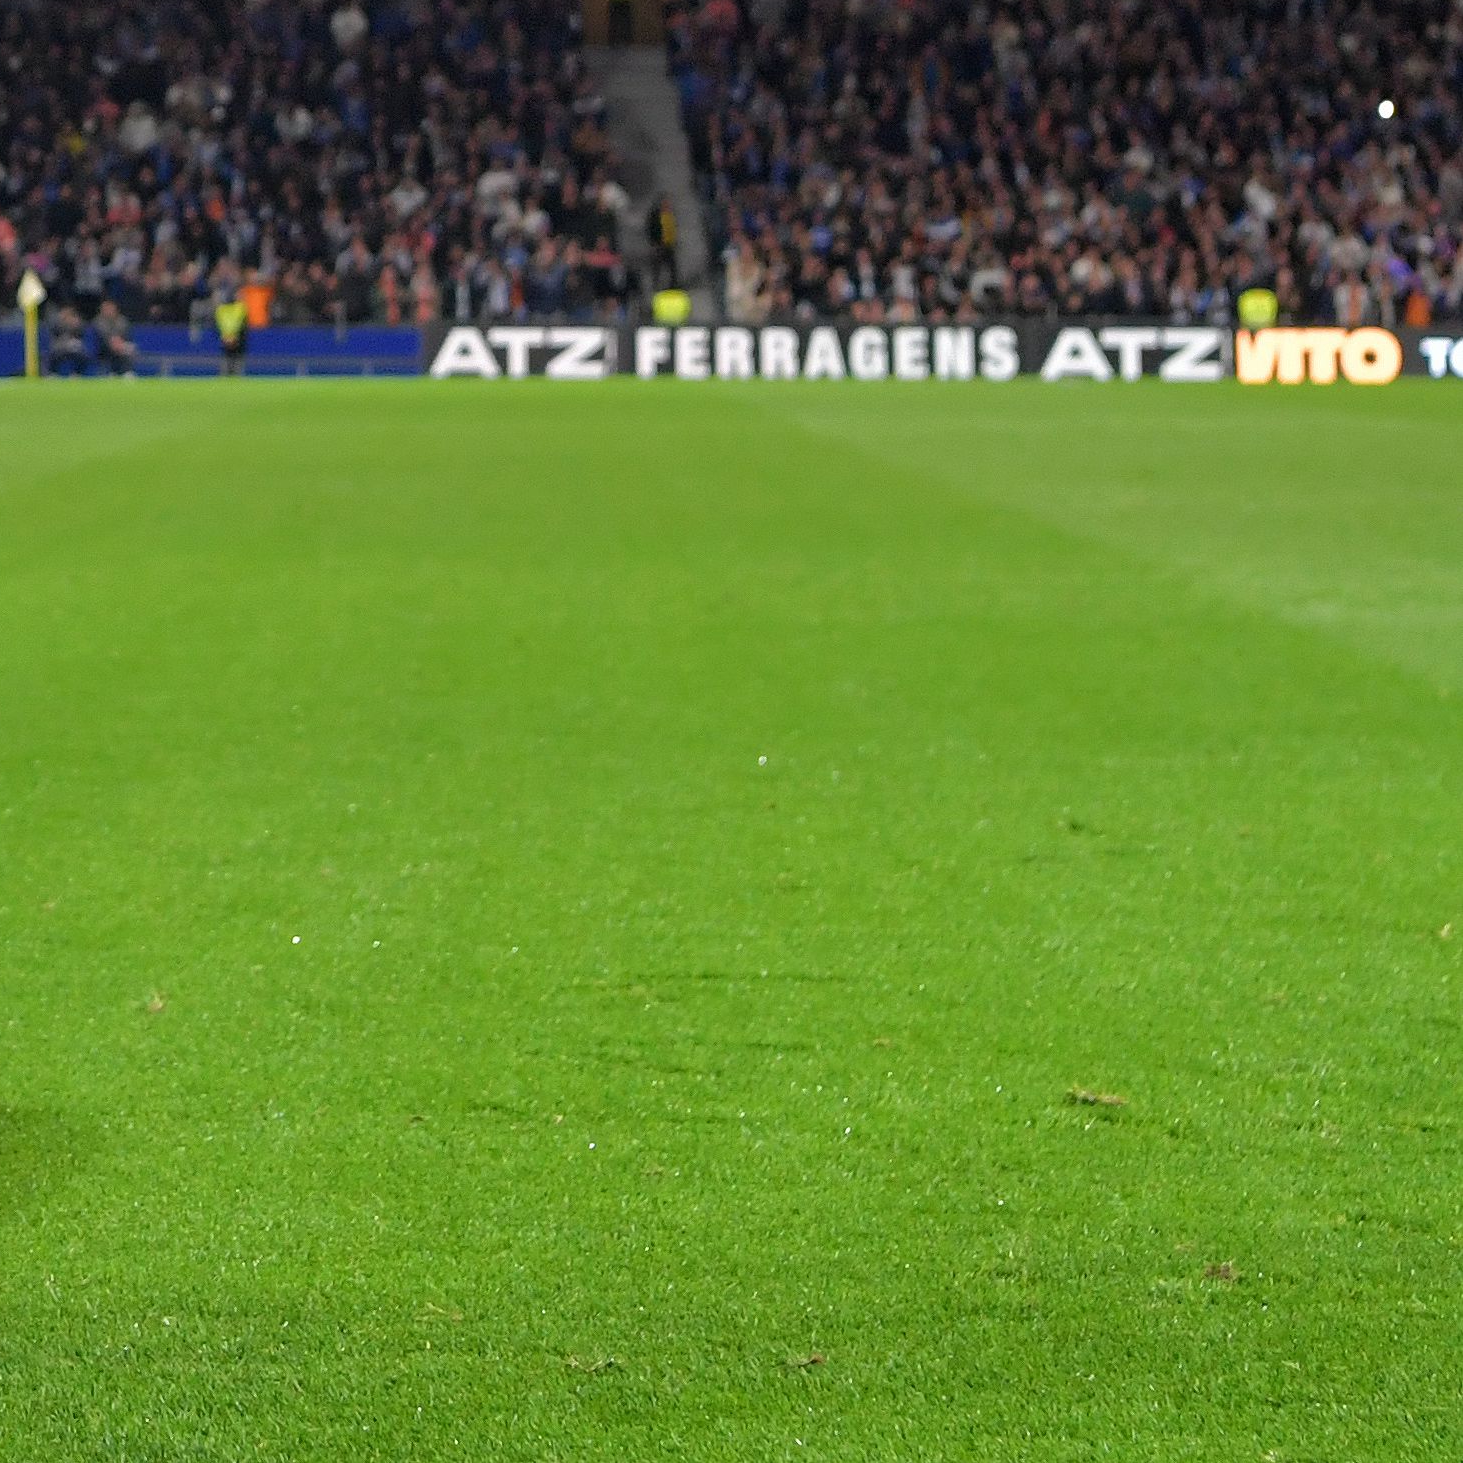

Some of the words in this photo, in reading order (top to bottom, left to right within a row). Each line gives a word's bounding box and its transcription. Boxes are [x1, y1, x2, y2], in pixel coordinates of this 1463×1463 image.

[429, 326, 609, 379] ATZ
[634, 326, 1020, 381] FERRAGENS
[1041, 326, 1224, 382] ATZ
[1236, 327, 1403, 385] VITO
